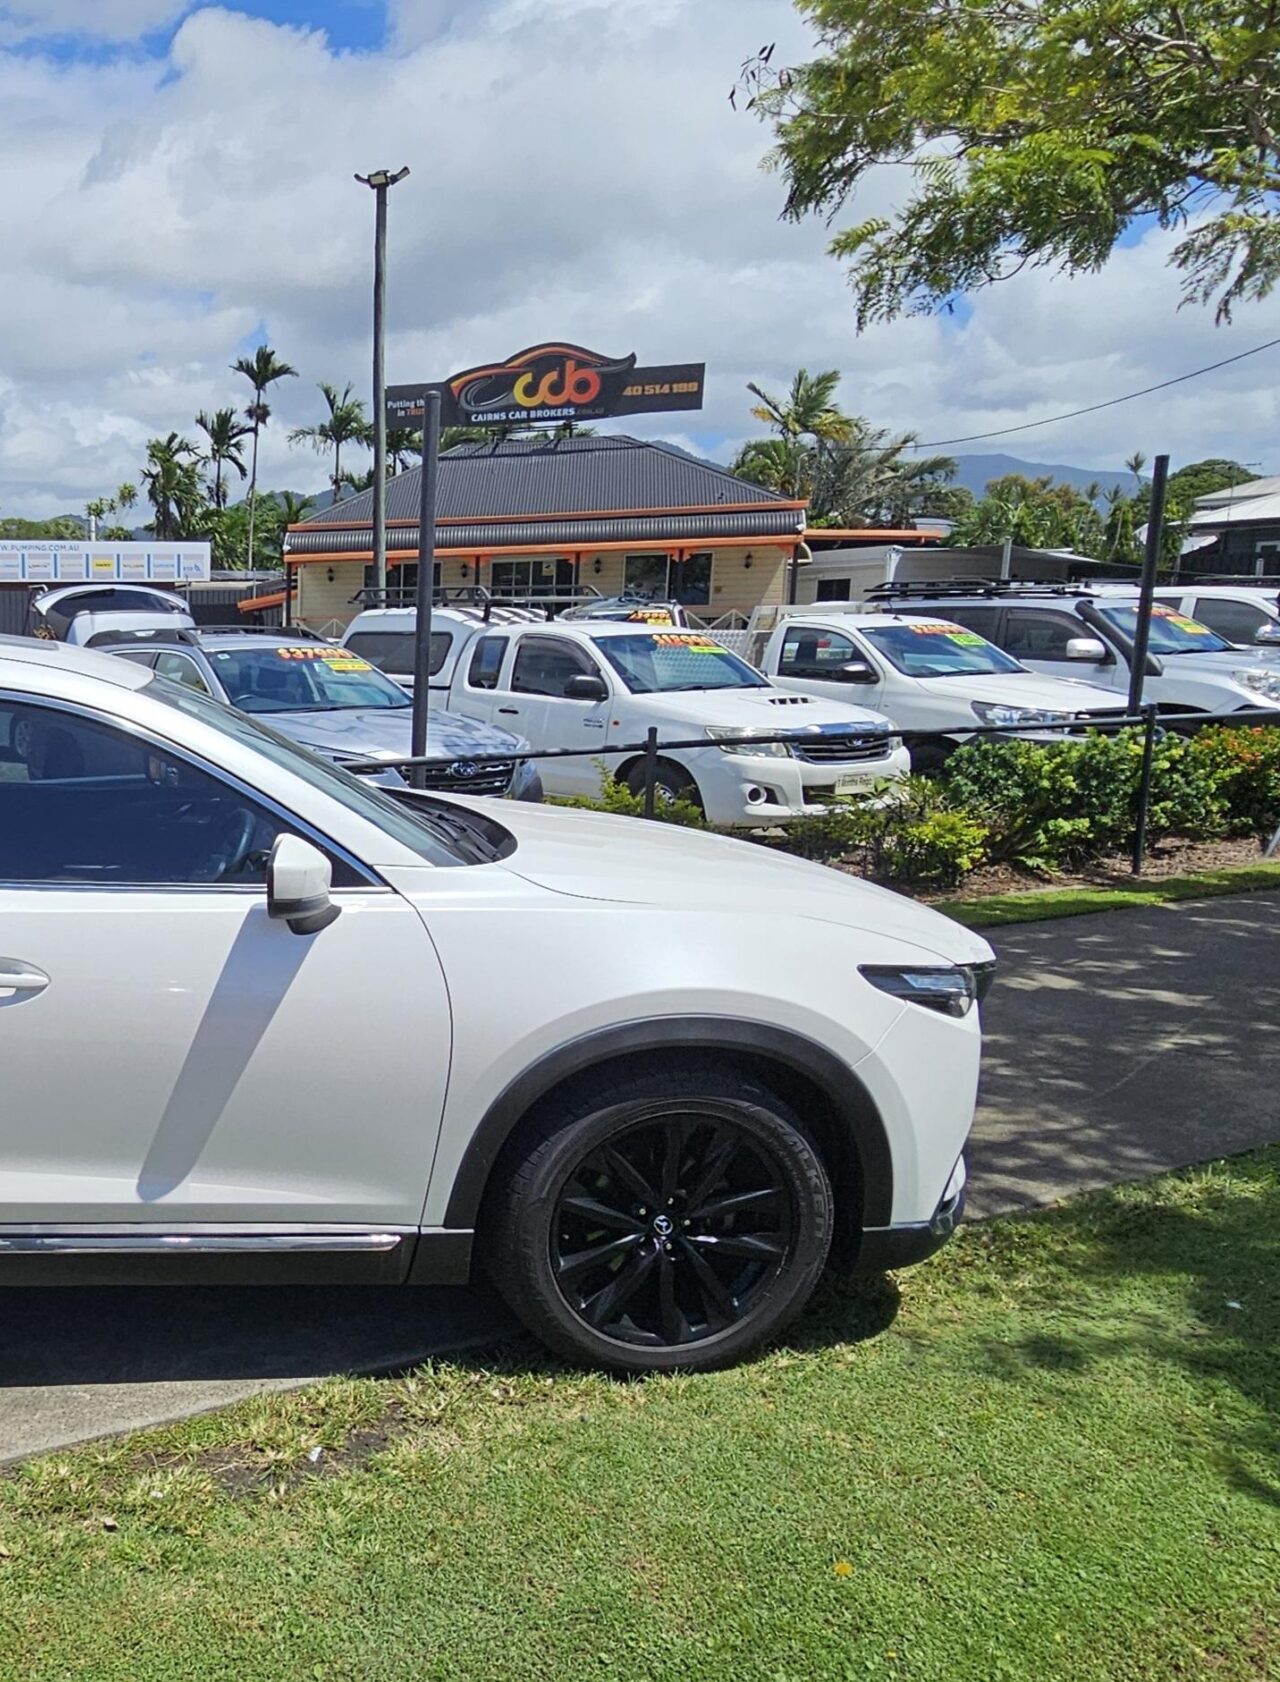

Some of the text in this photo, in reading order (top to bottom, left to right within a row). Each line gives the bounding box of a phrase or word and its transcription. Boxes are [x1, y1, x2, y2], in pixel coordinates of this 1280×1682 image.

[623, 382, 699, 396] 40 514 199
[387, 400, 416, 409] Putting
[471, 412, 506, 422] CAIRNS
[508, 411, 527, 420] CAR
